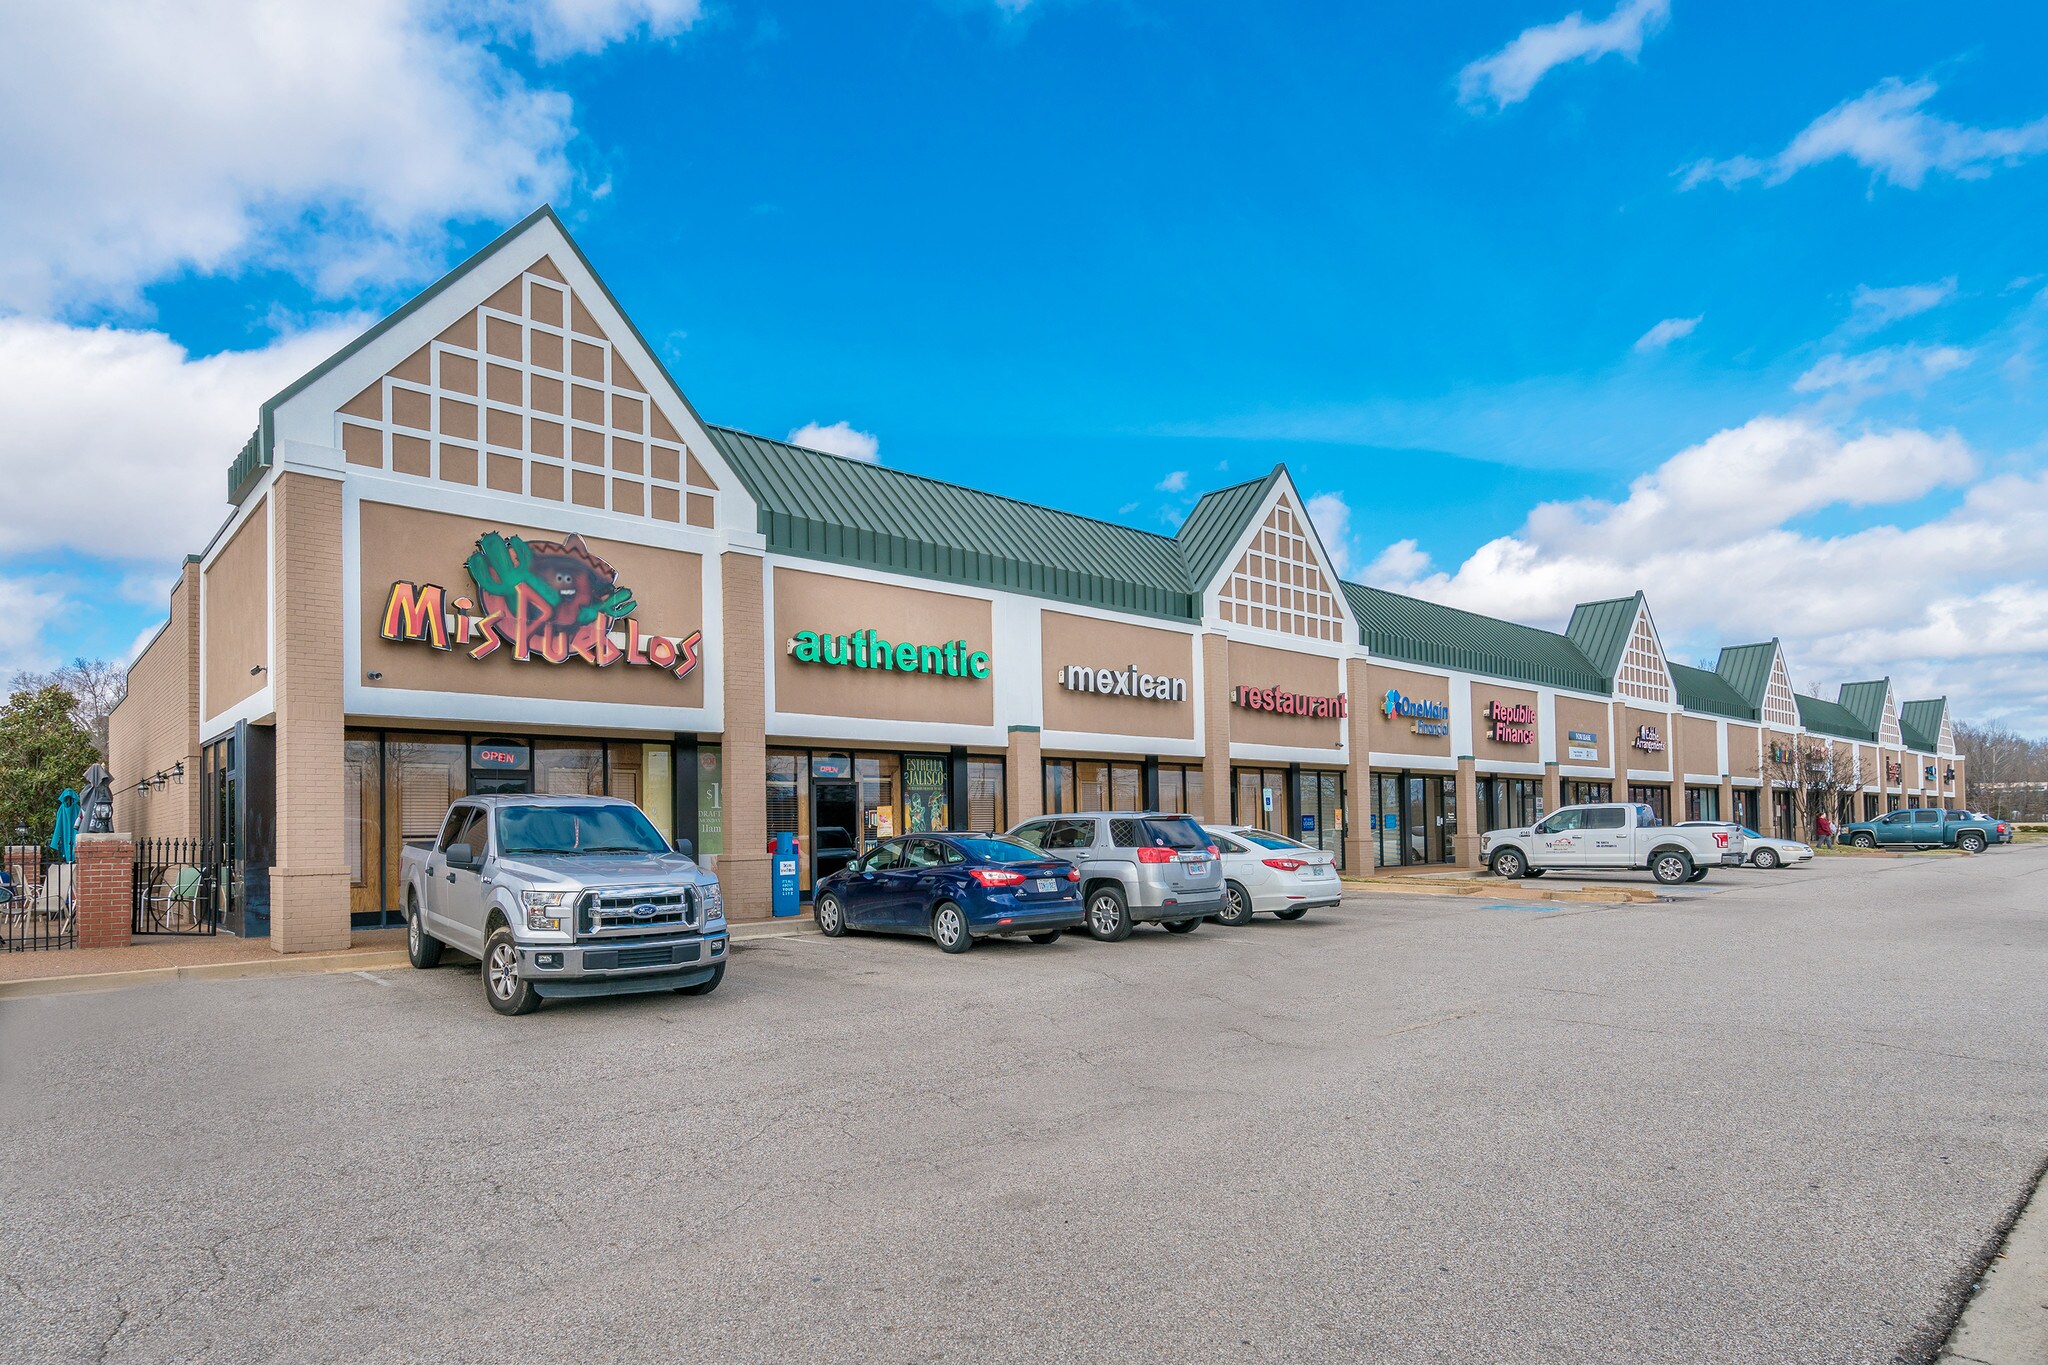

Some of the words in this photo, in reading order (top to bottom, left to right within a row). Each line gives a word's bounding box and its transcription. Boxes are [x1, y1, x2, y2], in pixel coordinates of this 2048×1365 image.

[381, 580, 505, 661] Mis
[794, 629, 991, 680] authentic
[1064, 664, 1187, 702] mexican
[1236, 684, 1347, 718] restaurant
[1400, 696, 1449, 720] OneMain
[1490, 700, 1536, 725] Republic
[1416, 719, 1449, 736] Financial
[1494, 722, 1535, 744] Finance
[481, 750, 515, 764] OPEN
[906, 758, 943, 771] ESTRELLA
[906, 770, 944, 785] JALISCO
